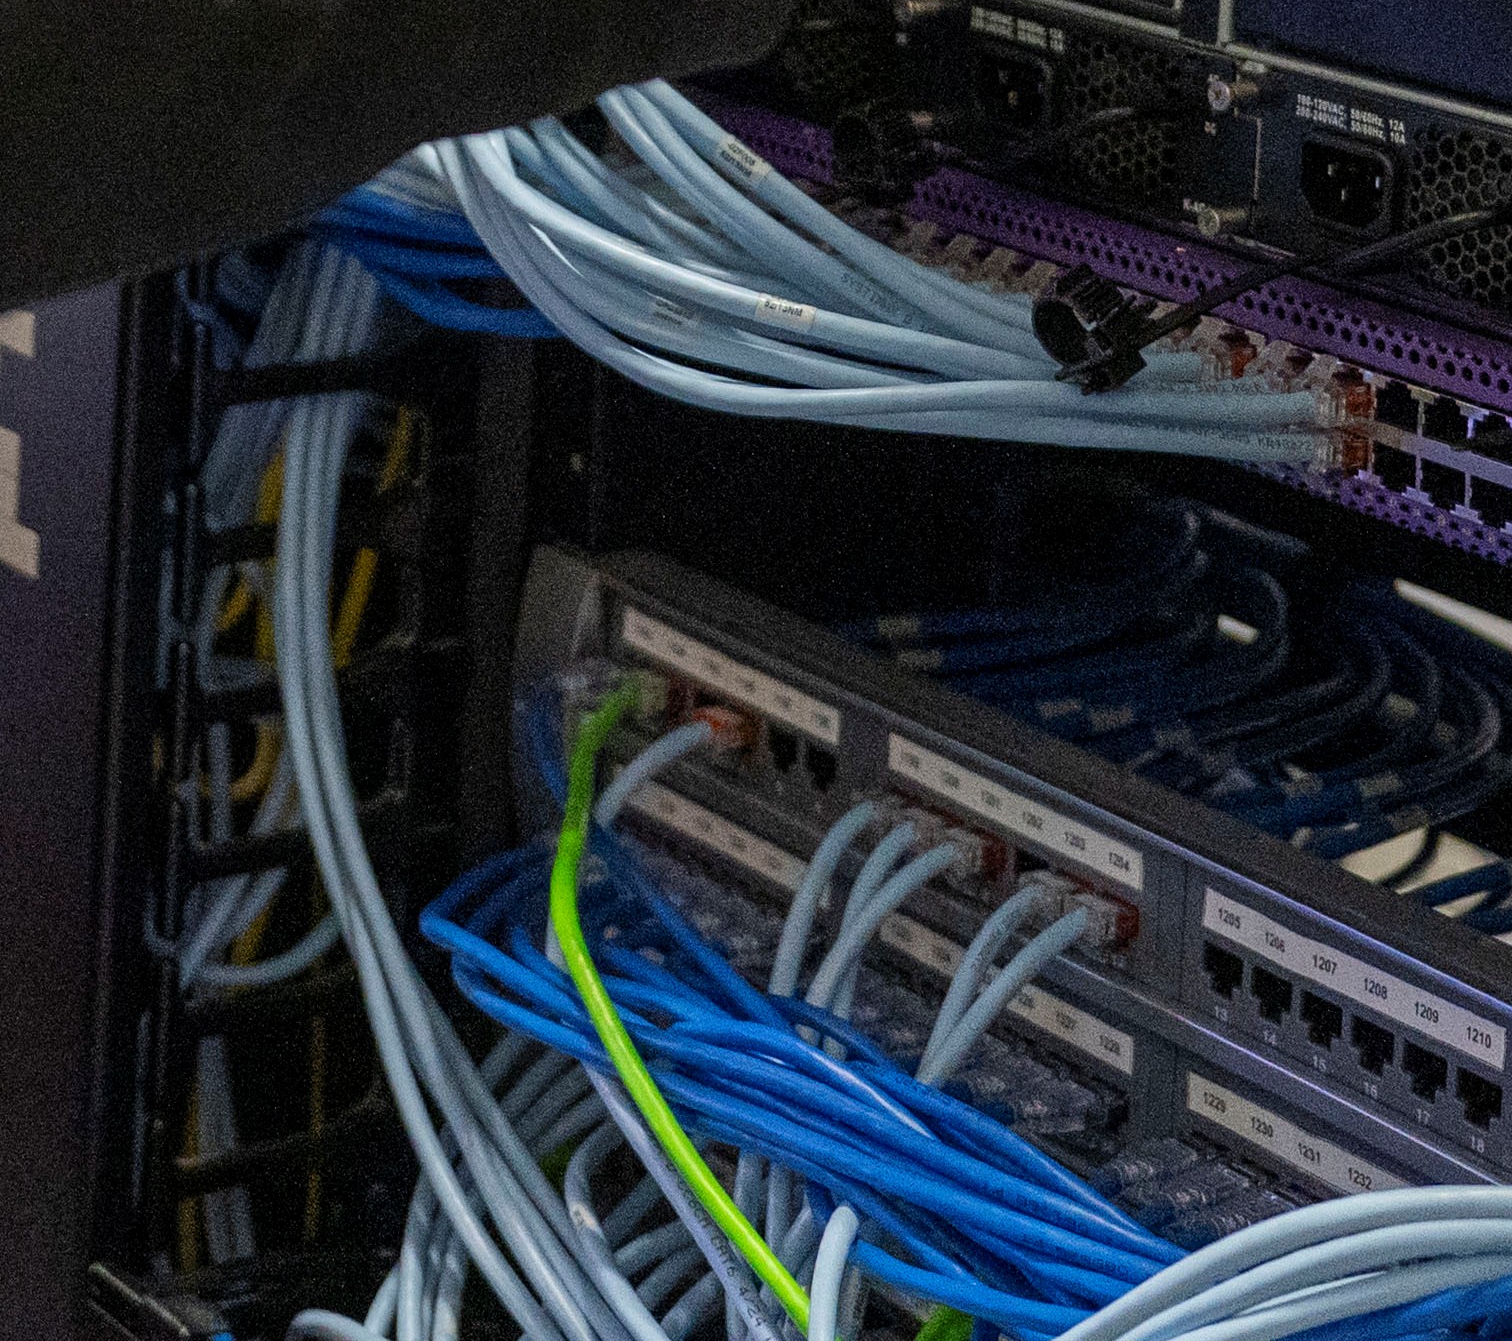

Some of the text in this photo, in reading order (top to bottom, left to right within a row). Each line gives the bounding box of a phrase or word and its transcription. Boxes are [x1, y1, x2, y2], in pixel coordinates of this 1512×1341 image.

[1389, 119, 1405, 133] 12A
[1216, 906, 1492, 1050] 1205 1206 1207 1208 1209 1210
[1250, 1115, 1275, 1139] 1230
[1297, 1141, 1322, 1165] 1231
[1347, 1166, 1373, 1190] 1232
[1470, 1136, 1486, 1153] 18
